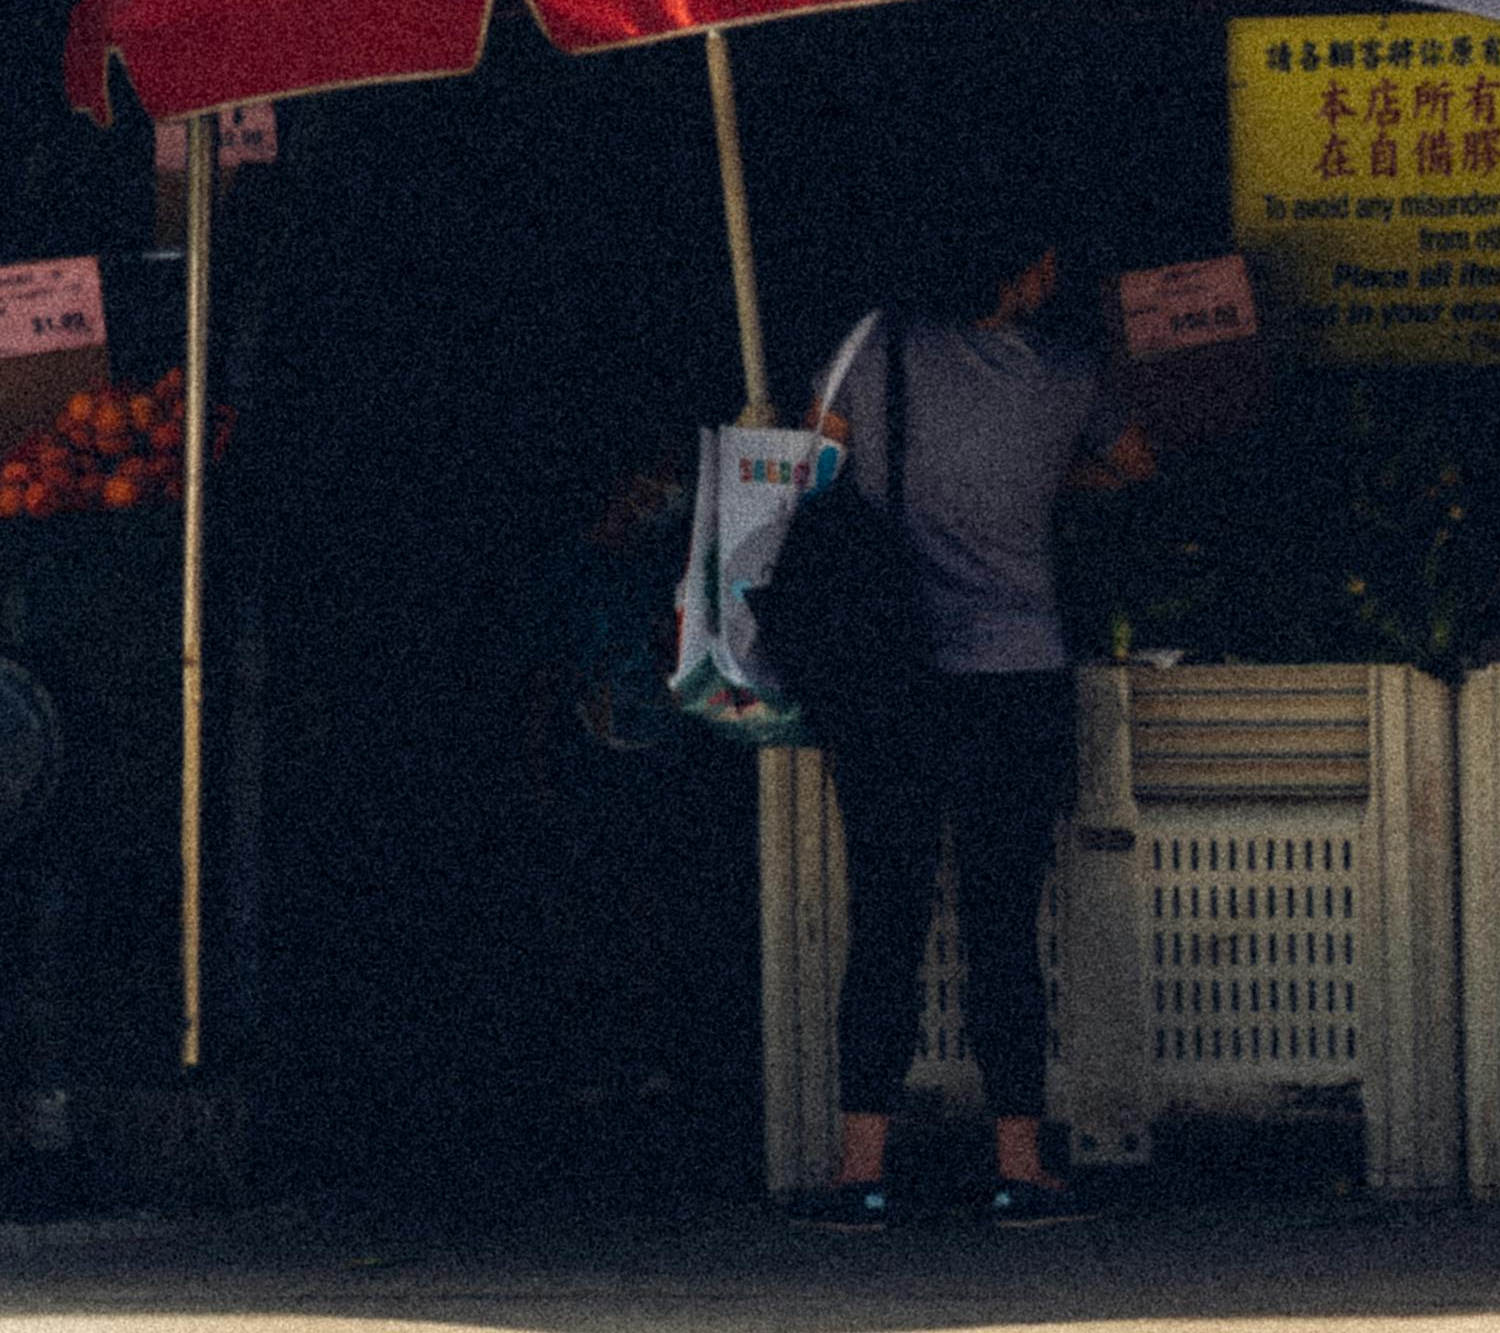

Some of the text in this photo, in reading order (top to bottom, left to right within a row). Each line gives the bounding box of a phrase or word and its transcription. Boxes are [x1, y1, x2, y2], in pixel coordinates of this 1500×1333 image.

[1293, 194, 1350, 219] avoid
[1357, 198, 1394, 222] any
[1332, 263, 1408, 289] Place
[1419, 262, 1452, 287] all
